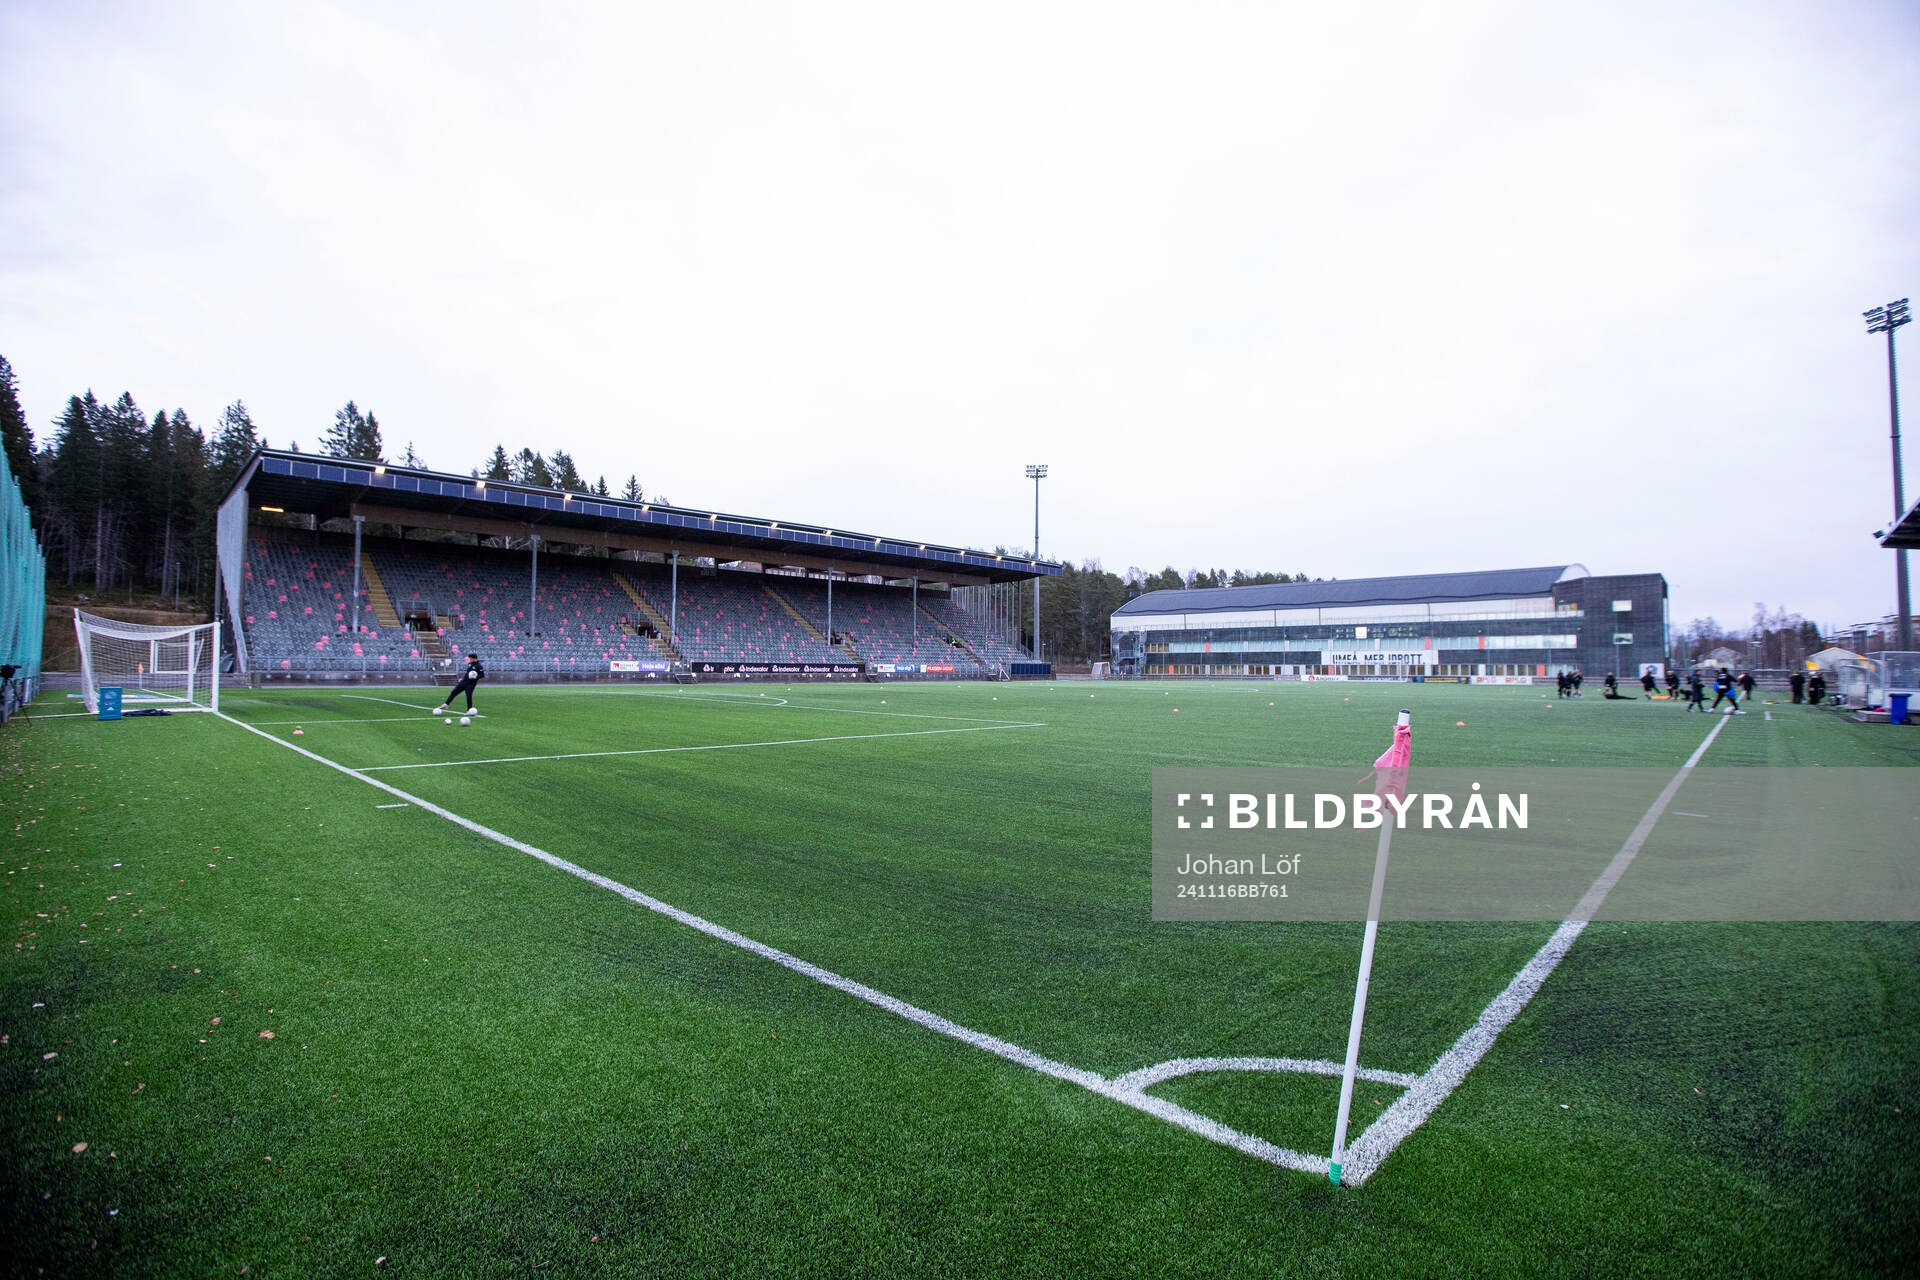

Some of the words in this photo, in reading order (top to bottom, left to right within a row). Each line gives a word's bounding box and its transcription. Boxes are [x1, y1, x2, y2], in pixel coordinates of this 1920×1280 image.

[1332, 651, 1358, 665] UMEÅ
[1364, 654, 1385, 665] MER
[1388, 654, 1422, 665] IDROTT
